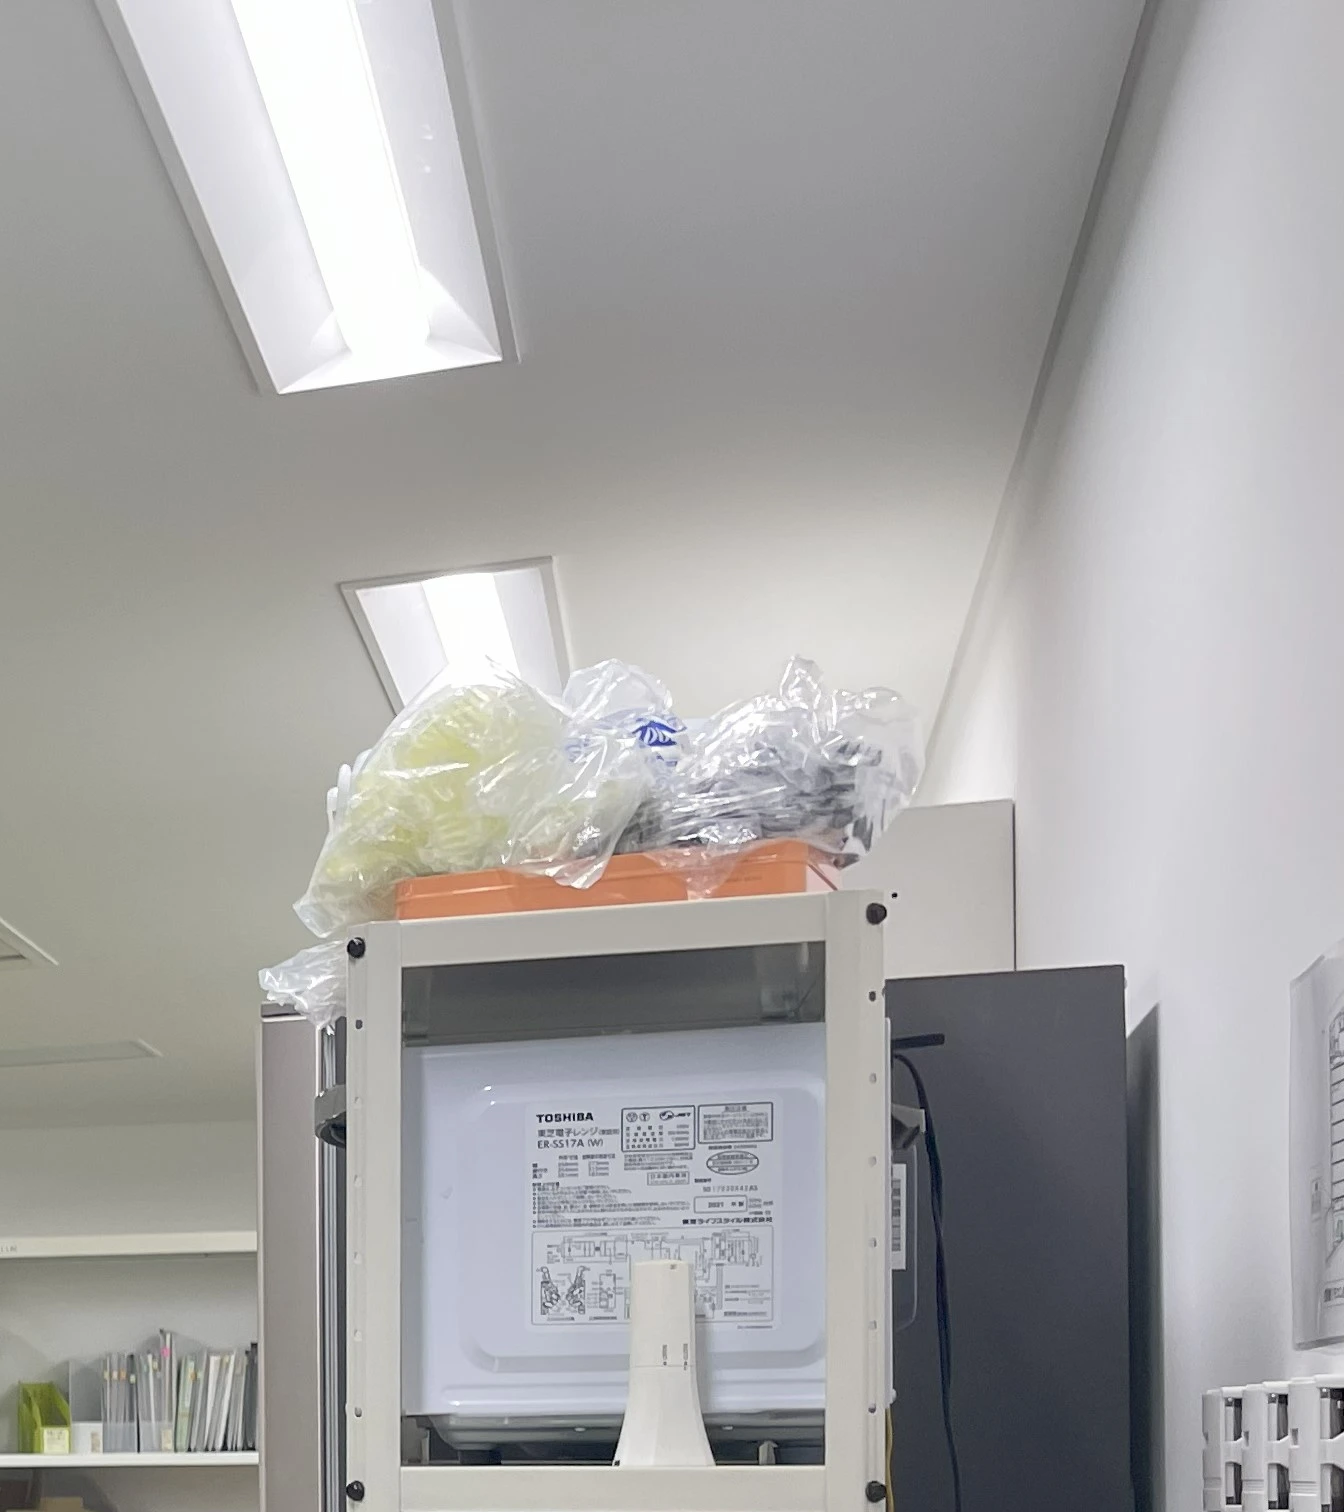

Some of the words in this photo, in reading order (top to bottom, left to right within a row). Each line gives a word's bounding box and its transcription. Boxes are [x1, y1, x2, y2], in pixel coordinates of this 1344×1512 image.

[536, 1112, 594, 1123] TOSHIBA
[537, 1139, 585, 1149] ER-SS17A
[587, 1138, 604, 1148] (W)
